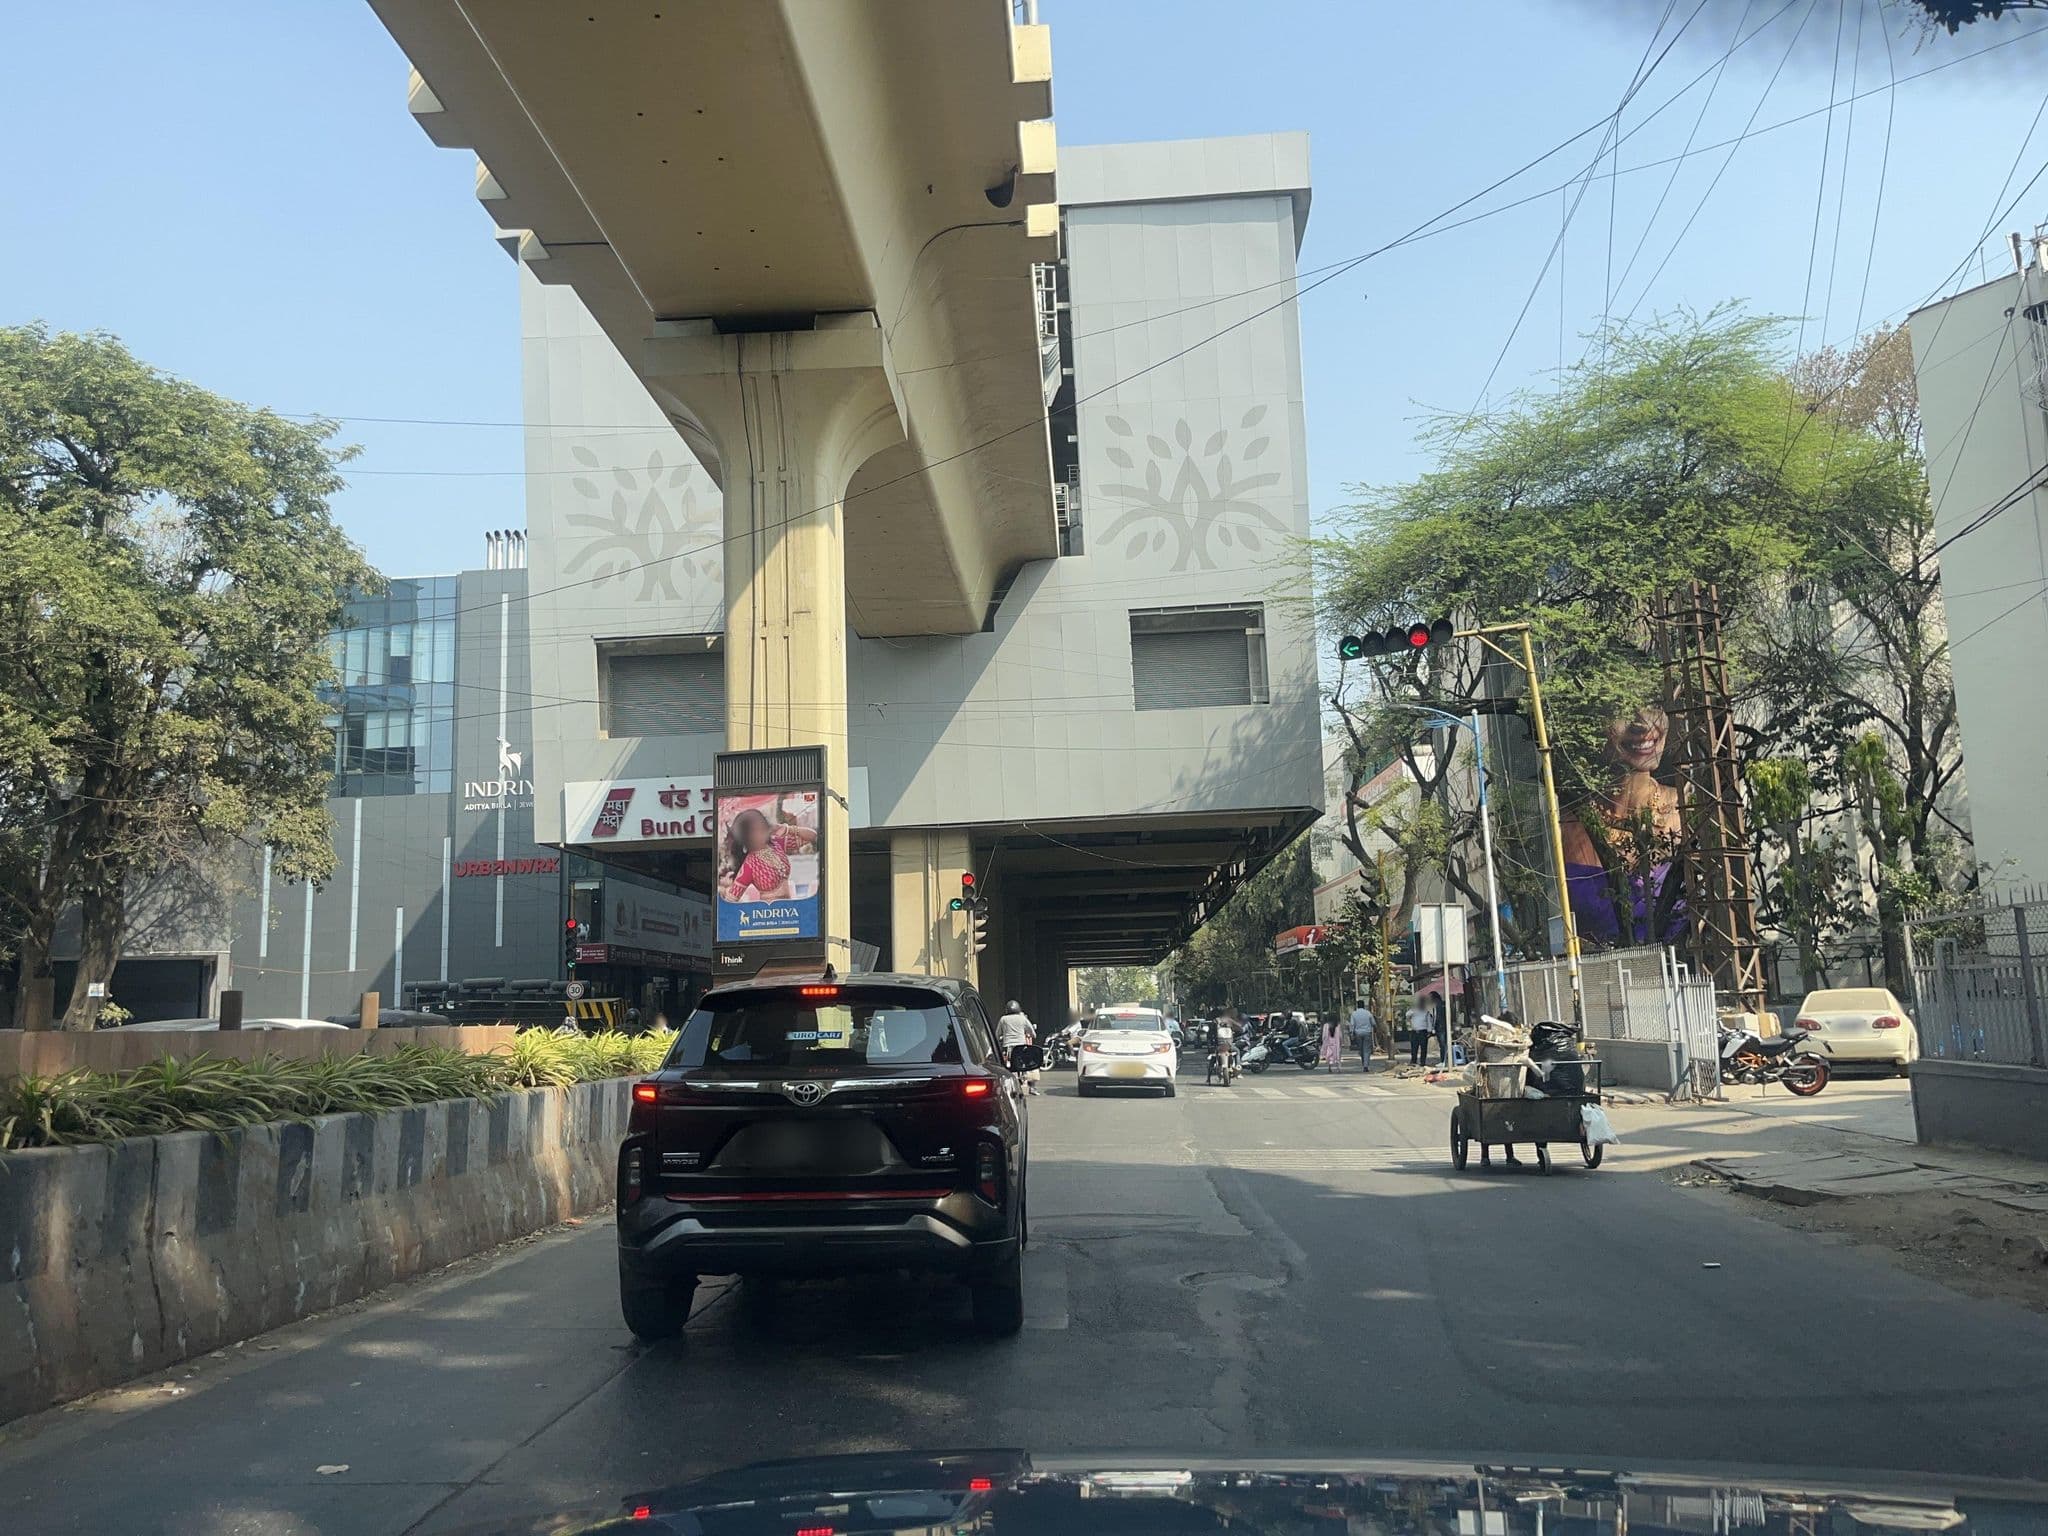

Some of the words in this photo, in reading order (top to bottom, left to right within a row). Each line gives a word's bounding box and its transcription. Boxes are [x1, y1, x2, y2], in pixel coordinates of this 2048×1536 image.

[464, 802, 490, 811] ADITYA
[641, 815, 695, 836] Bund
[752, 907, 799, 919] INDRIYA
[570, 985, 580, 994] 30
